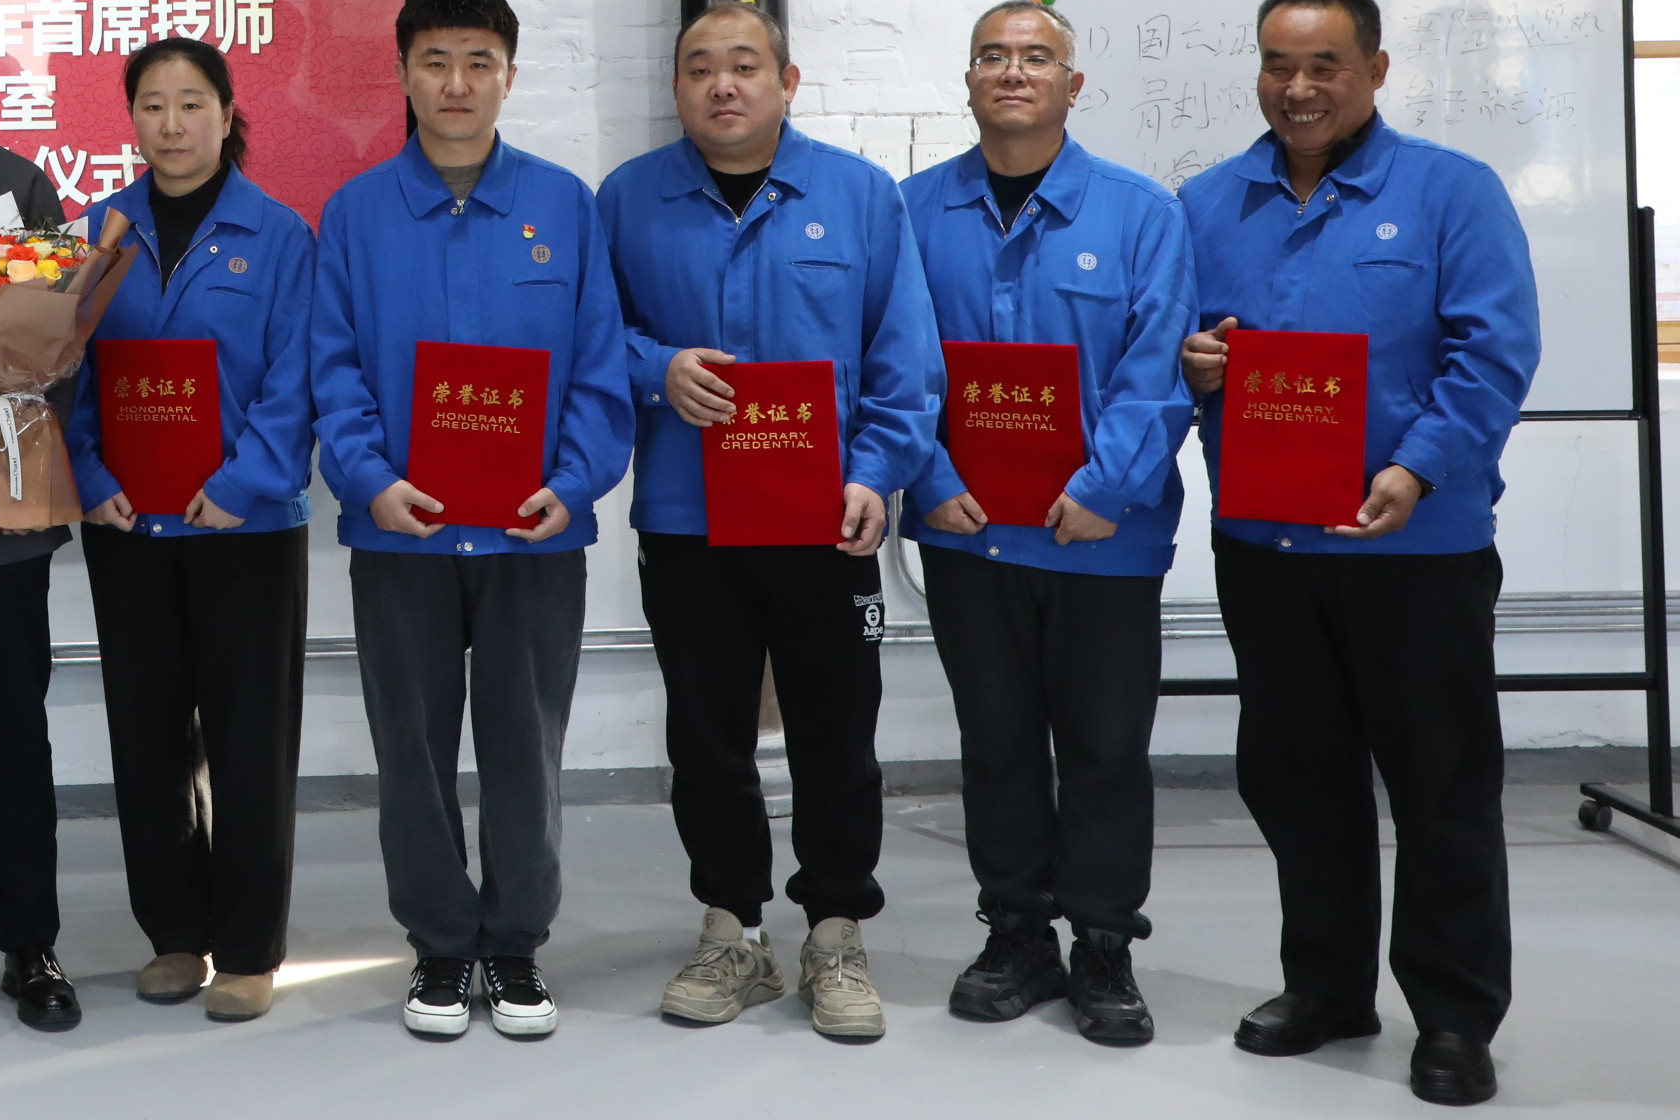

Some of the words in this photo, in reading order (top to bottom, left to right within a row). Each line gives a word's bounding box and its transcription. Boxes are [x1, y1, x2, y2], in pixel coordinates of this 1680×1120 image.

[114, 376, 196, 399] 荣誉证书
[1243, 369, 1341, 398] 荣誉证书
[432, 381, 524, 410] 荣誉证书
[963, 380, 1055, 407] 荣誉证书
[120, 405, 192, 414] HONORARY
[722, 401, 813, 426] 誉证书
[1248, 402, 1335, 414] HONORARY
[116, 414, 197, 422] CREDENTIAL
[436, 411, 517, 425] HONORARY
[969, 411, 1051, 422] HONORARY
[1242, 410, 1339, 424] CREDENTIAL
[431, 420, 521, 434] CREDENTIAL
[965, 420, 1057, 431] CREDENTIAL
[725, 431, 808, 441] HONORARY
[721, 440, 814, 450] CREDENTIAL
[863, 626, 883, 637] Aape
